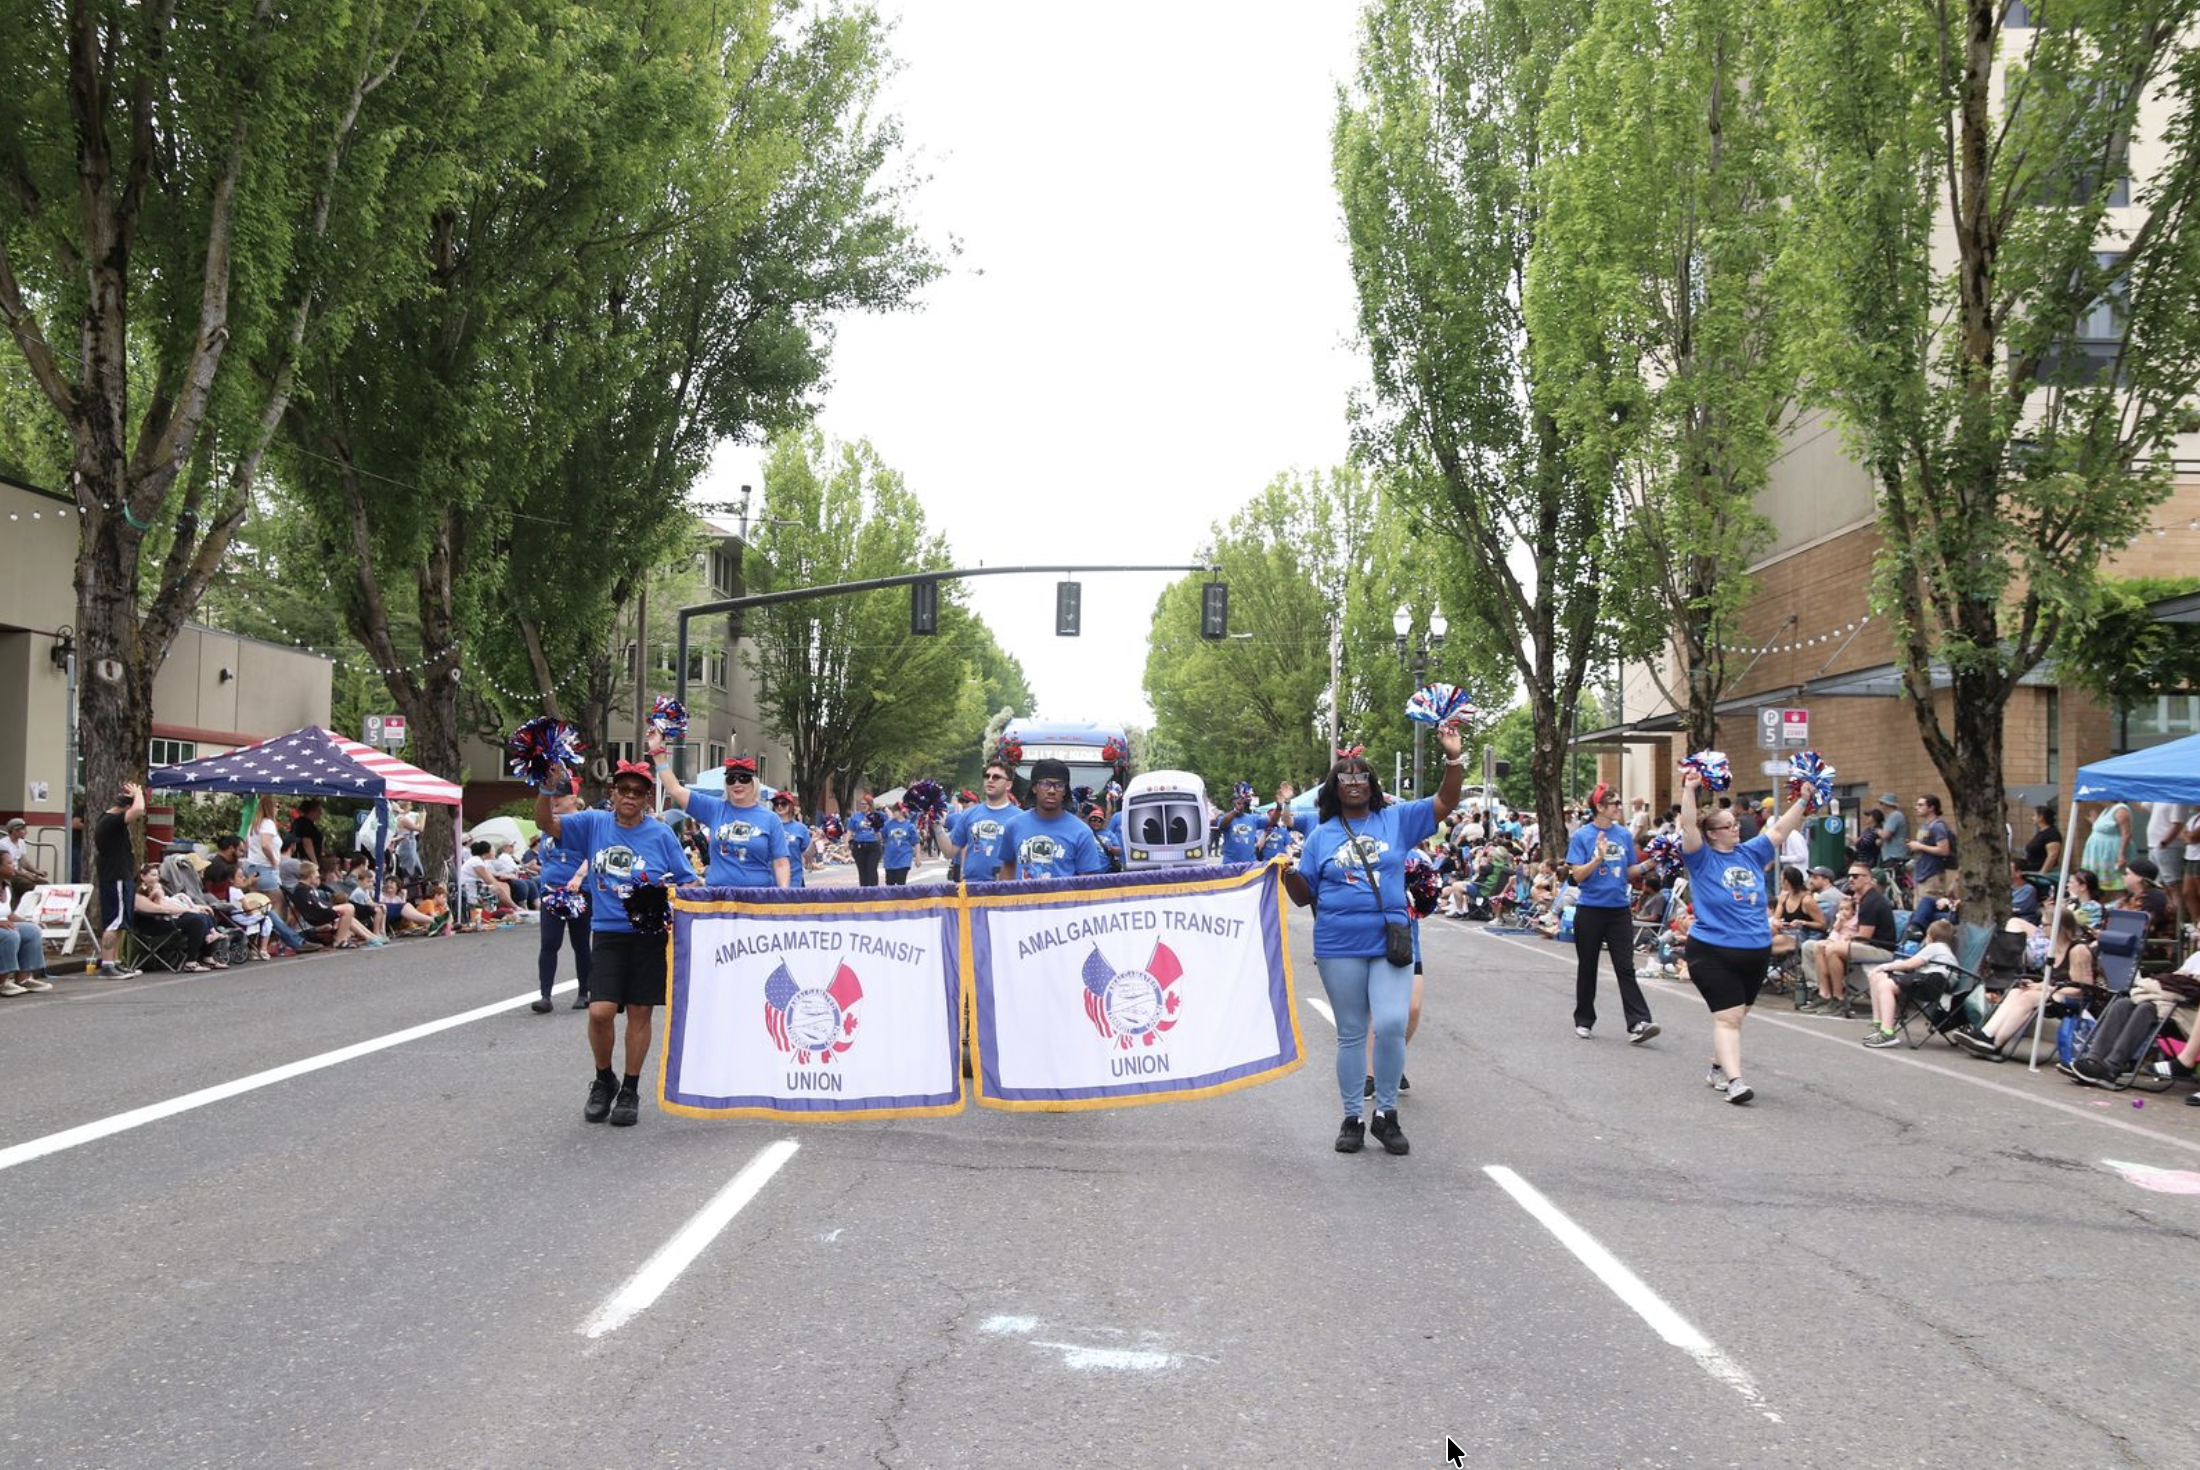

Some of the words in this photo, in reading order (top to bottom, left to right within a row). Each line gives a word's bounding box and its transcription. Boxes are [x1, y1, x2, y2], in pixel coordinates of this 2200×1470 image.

[369, 730, 378, 742] 5
[1765, 728, 1776, 742] 5
[1017, 910, 1157, 960] AMALGAMATED
[1162, 910, 1245, 939] TRANSIT
[714, 930, 842, 968] AMALGAMATED
[849, 932, 926, 966] TRANSIT
[1110, 1053, 1170, 1078] UNION
[786, 1071, 843, 1092] UNION
